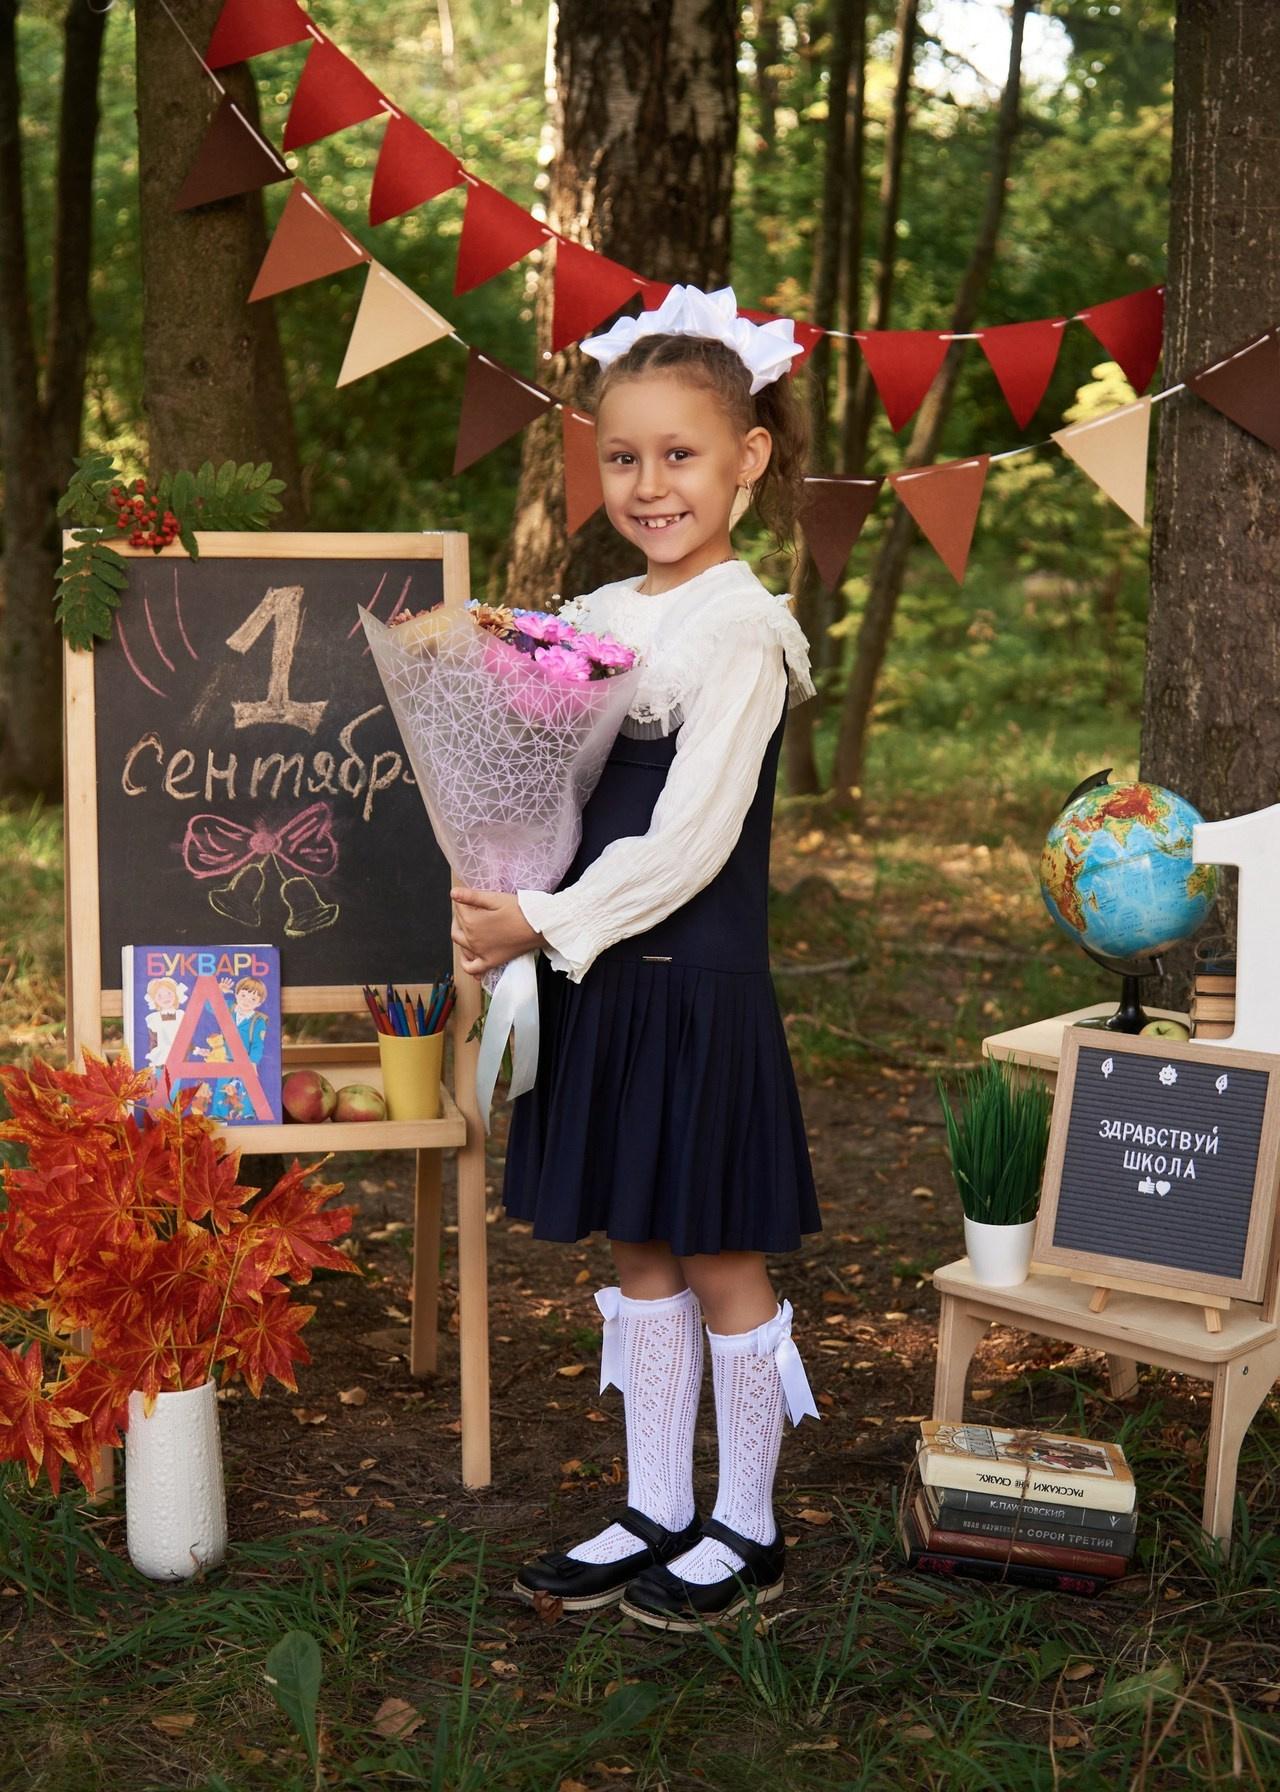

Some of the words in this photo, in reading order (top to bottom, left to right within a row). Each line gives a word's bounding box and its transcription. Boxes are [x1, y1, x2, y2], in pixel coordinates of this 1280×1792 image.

[226, 586, 328, 736] 1
[121, 705, 416, 822] Сентябр
[147, 953, 270, 977] БУКВАРЬ
[1099, 1119, 1219, 1155] ЗДРАВСТВУЙ
[1123, 1150, 1197, 1180] ШКОЛА
[1034, 1482, 1084, 1498] РАССКАЖИ
[1069, 1534, 1114, 1549] ТРЕТИЙ
